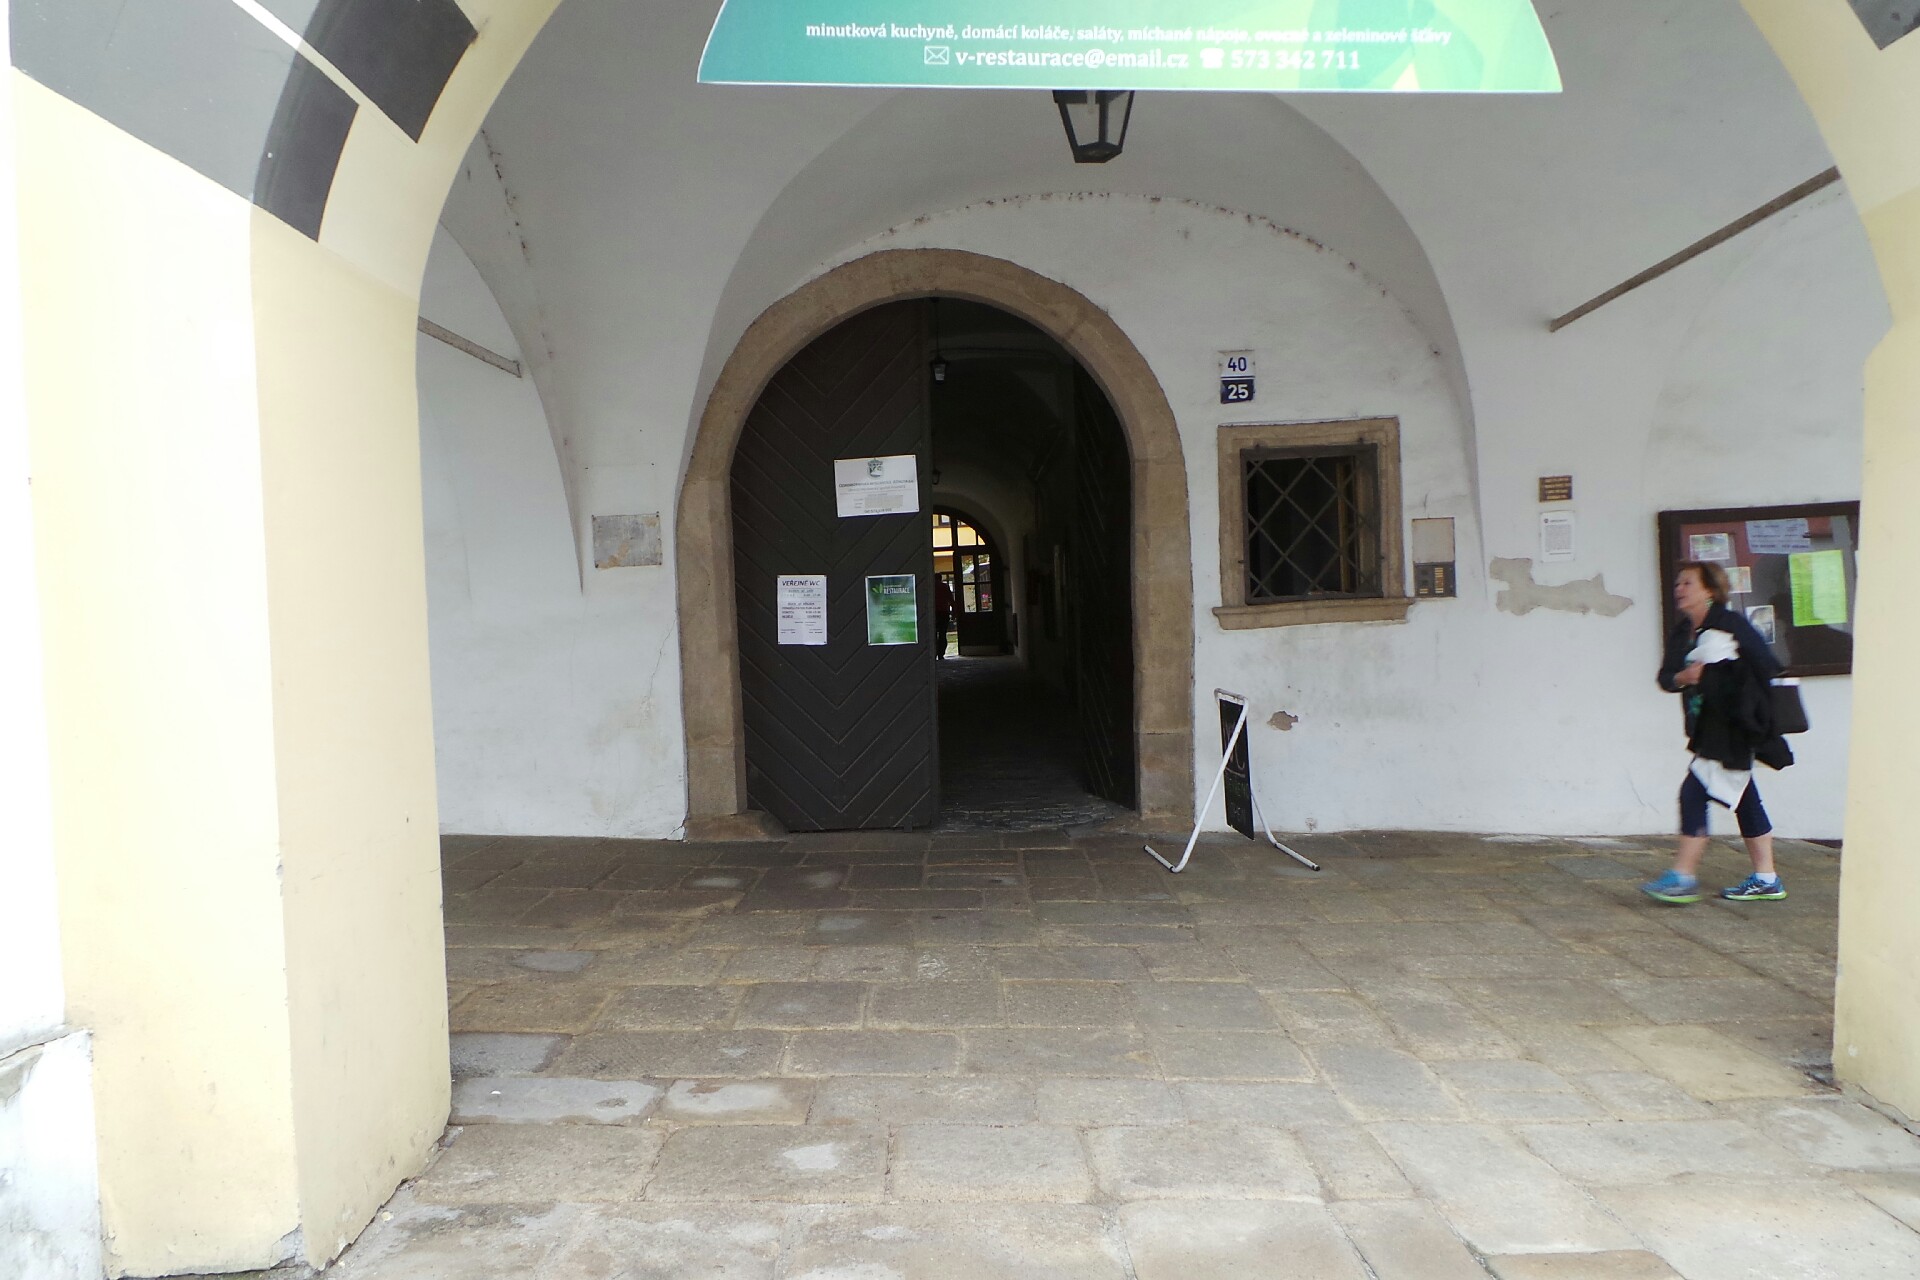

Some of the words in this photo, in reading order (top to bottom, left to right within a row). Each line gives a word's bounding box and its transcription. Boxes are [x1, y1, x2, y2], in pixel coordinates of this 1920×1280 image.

[806, 23, 887, 38] minutková
[891, 24, 958, 40] kuchyně,
[961, 24, 1018, 39] domácí
[1021, 25, 1074, 41] koláče,
[1077, 26, 1123, 44] saláty,
[1128, 26, 1192, 41] míchané
[1325, 27, 1407, 42] zeleninové
[955, 48, 1189, 68] v-restaurace@email.cz
[1230, 49, 1270, 69] 573
[1275, 49, 1315, 69] 342
[1321, 49, 1360, 70] 711
[1227, 356, 1247, 372] 40
[1227, 384, 1249, 400] 25
